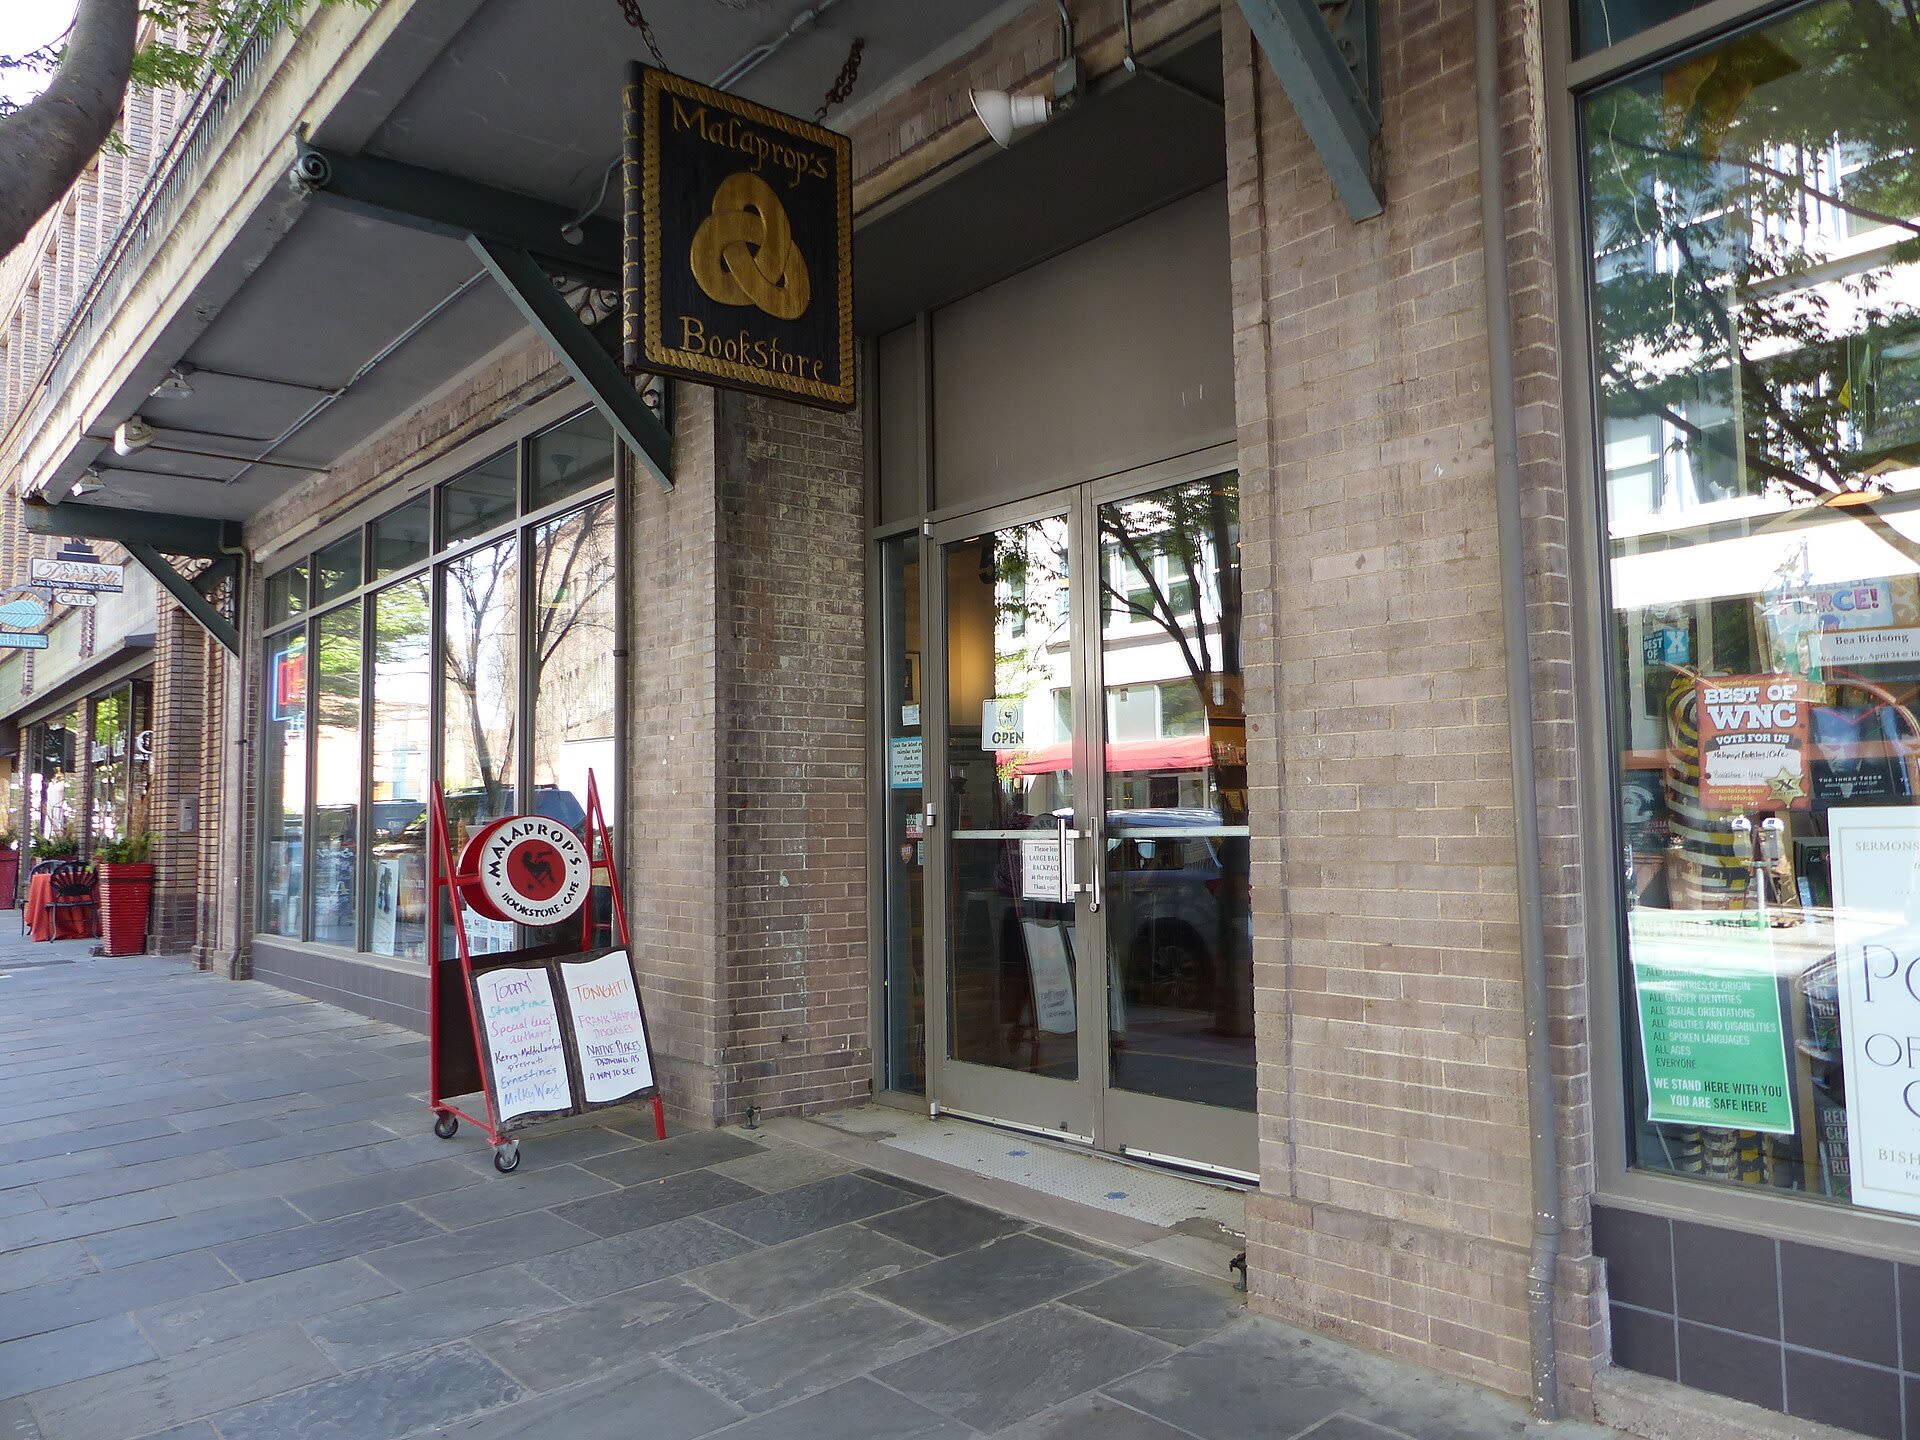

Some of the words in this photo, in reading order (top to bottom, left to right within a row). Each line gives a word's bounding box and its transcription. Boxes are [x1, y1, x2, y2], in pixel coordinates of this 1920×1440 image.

[672, 98, 828, 189] Malaprop's
[679, 315, 824, 381] Bookstore
[60, 594, 93, 605] CAFE
[1835, 636, 1854, 645] Bea
[1858, 634, 1910, 645] Birdsong
[1868, 652, 1889, 662] April
[1704, 687, 1760, 704] BEST
[1767, 684, 1797, 701] OF
[1707, 702, 1797, 730] WNC
[992, 732, 1024, 744] OPEN
[1716, 734, 1745, 745] VOTE
[1747, 733, 1771, 743] FOR
[1773, 734, 1790, 743] US
[488, 823, 582, 878] MALAPROP'S
[1855, 841, 1920, 851] SERMONS
[502, 892, 561, 917] BOOKSTORE
[563, 881, 579, 905] CAFE
[1649, 993, 1663, 1002] ALL
[1664, 993, 1697, 1003] GENDER
[1699, 994, 1742, 1004] IDENTITIES
[1650, 1006, 1665, 1015] ALL
[1665, 1006, 1695, 1016] SEXUAL
[1697, 1007, 1756, 1018] ORIENTATIONS
[490, 1018, 527, 1038] Special
[578, 1014, 610, 1029] FRANK
[1652, 1019, 1665, 1028] ALL
[1668, 1019, 1704, 1030] ABILITIES
[1705, 1021, 1722, 1030] AND
[1725, 1022, 1777, 1033] DISABILITIES
[1653, 1032, 1666, 1041] ALL
[1668, 1032, 1700, 1042] SPOKEN
[1702, 1034, 1750, 1045] LANGUAGES
[586, 1043, 615, 1057] NATIVE
[615, 1040, 641, 1054] PLACES
[1655, 1045, 1669, 1054] ALL
[1670, 1046, 1691, 1056] AGES
[631, 1055, 640, 1063] AS
[1656, 1058, 1696, 1069] EVERYONE
[597, 1071, 612, 1079] WAY
[613, 1069, 621, 1077] TO
[622, 1067, 636, 1076] SEE
[504, 1087, 535, 1106] Milky
[534, 1080, 566, 1100] Way
[1653, 1078, 1669, 1089] WE
[1671, 1079, 1701, 1091] STAND
[1704, 1081, 1730, 1094] HERE
[1732, 1082, 1758, 1095] WITH
[1761, 1085, 1782, 1097] YOU
[1670, 1094, 1689, 1106] YOU
[1692, 1096, 1711, 1108] ARE
[1714, 1098, 1739, 1110] SAFE
[1741, 1100, 1768, 1113] HERE
